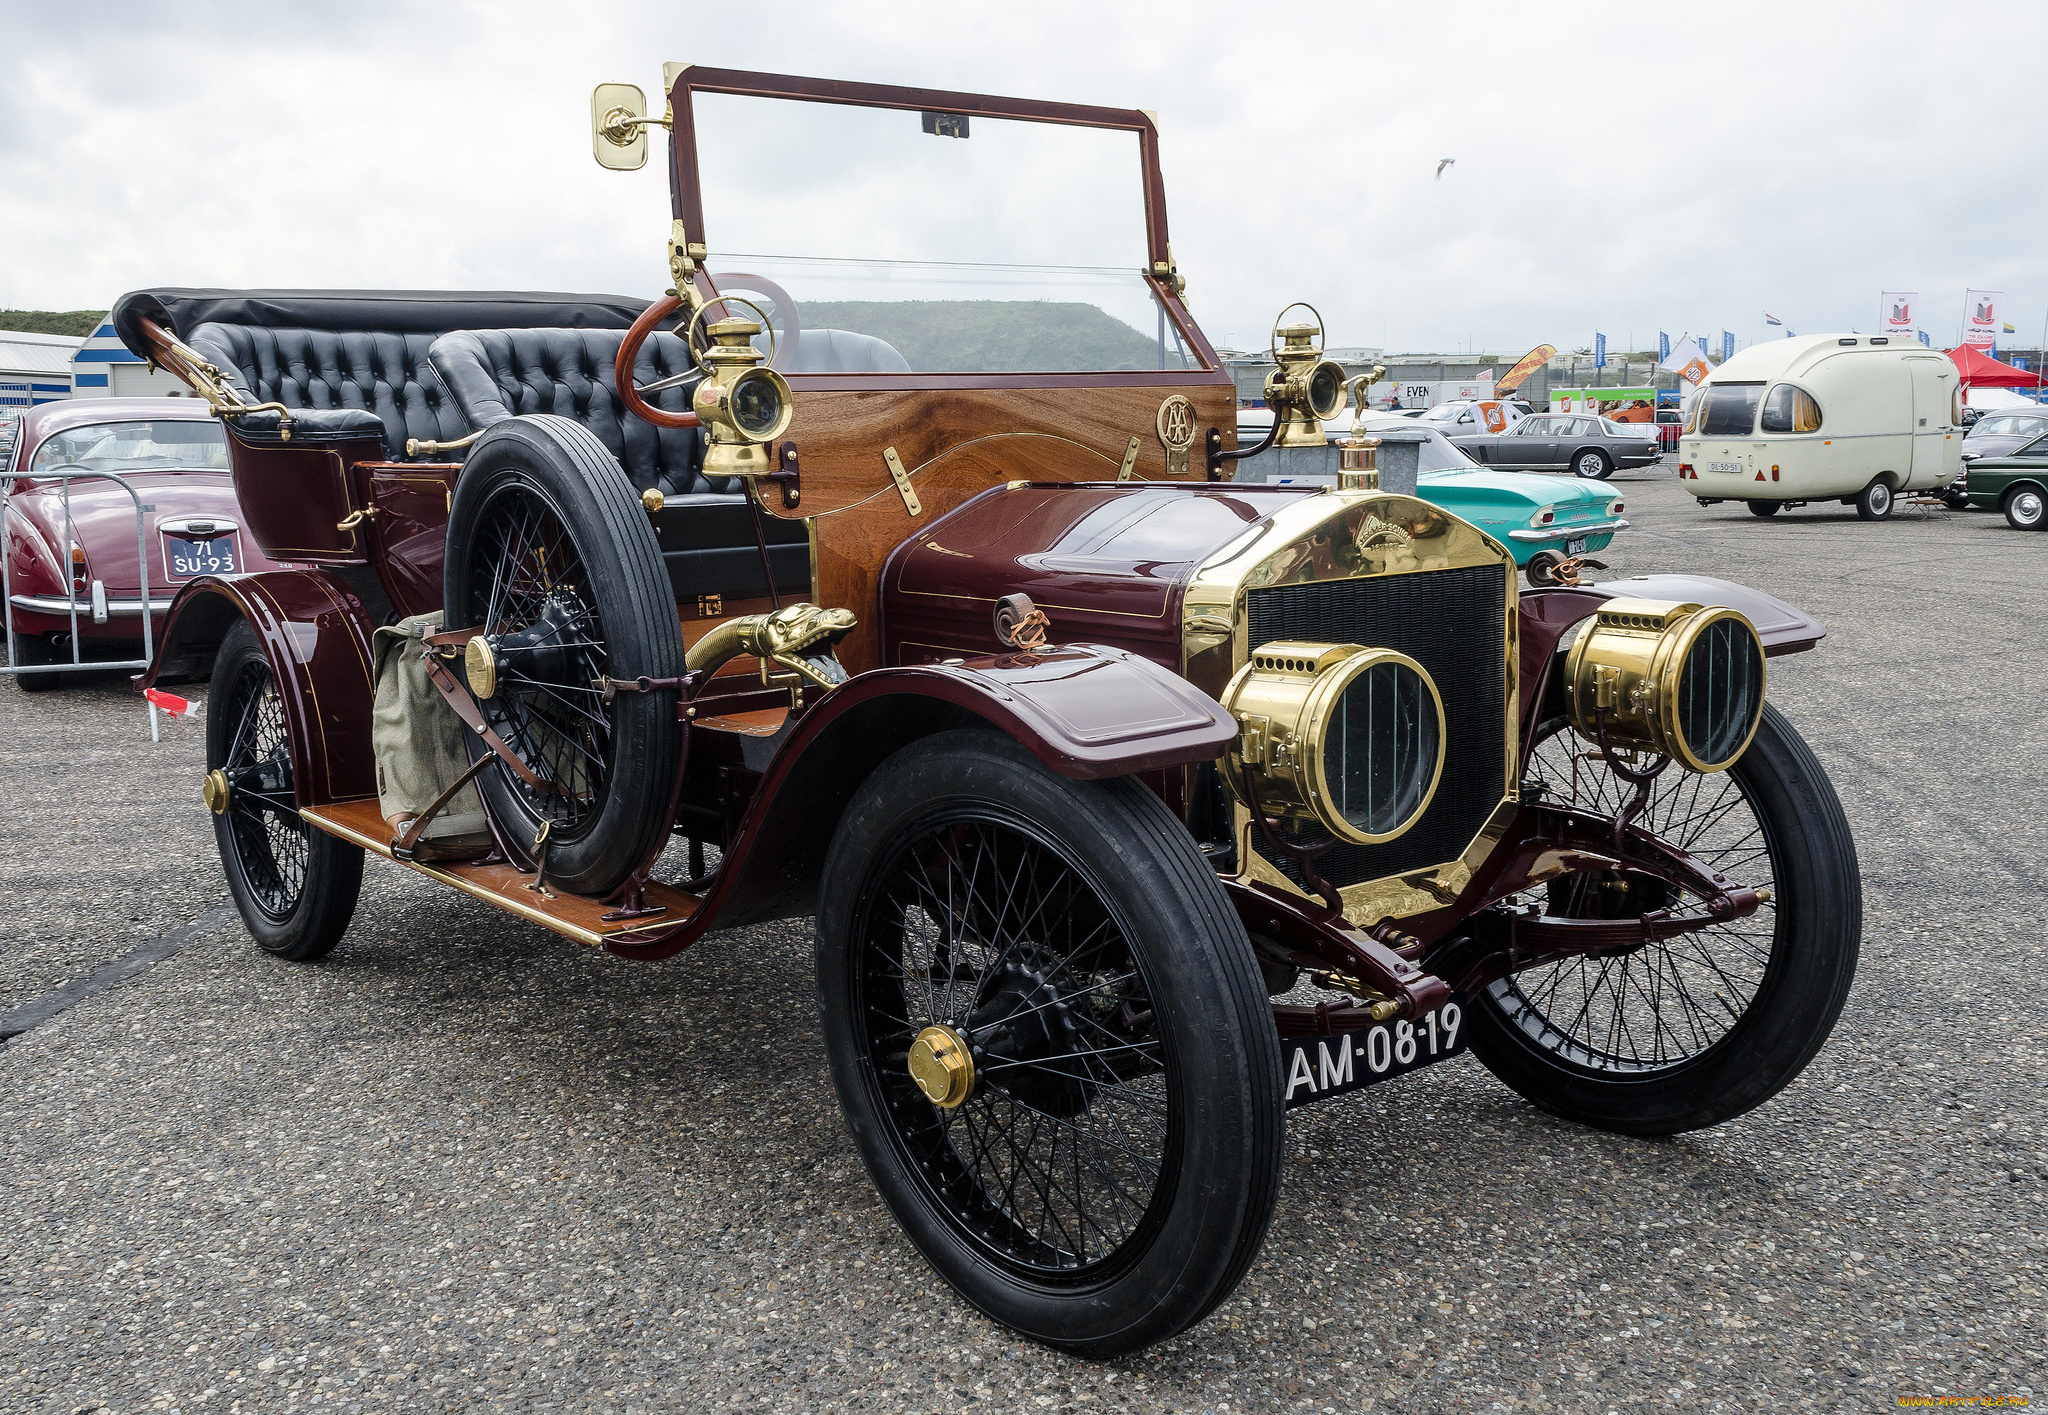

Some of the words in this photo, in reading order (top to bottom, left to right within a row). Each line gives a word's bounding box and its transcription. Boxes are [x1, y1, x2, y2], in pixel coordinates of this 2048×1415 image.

[1517, 358, 1543, 371] FRITES
[193, 541, 212, 556] 71
[175, 557, 235, 573] SU-93
[1284, 1002, 1461, 1100] AM-08-19
